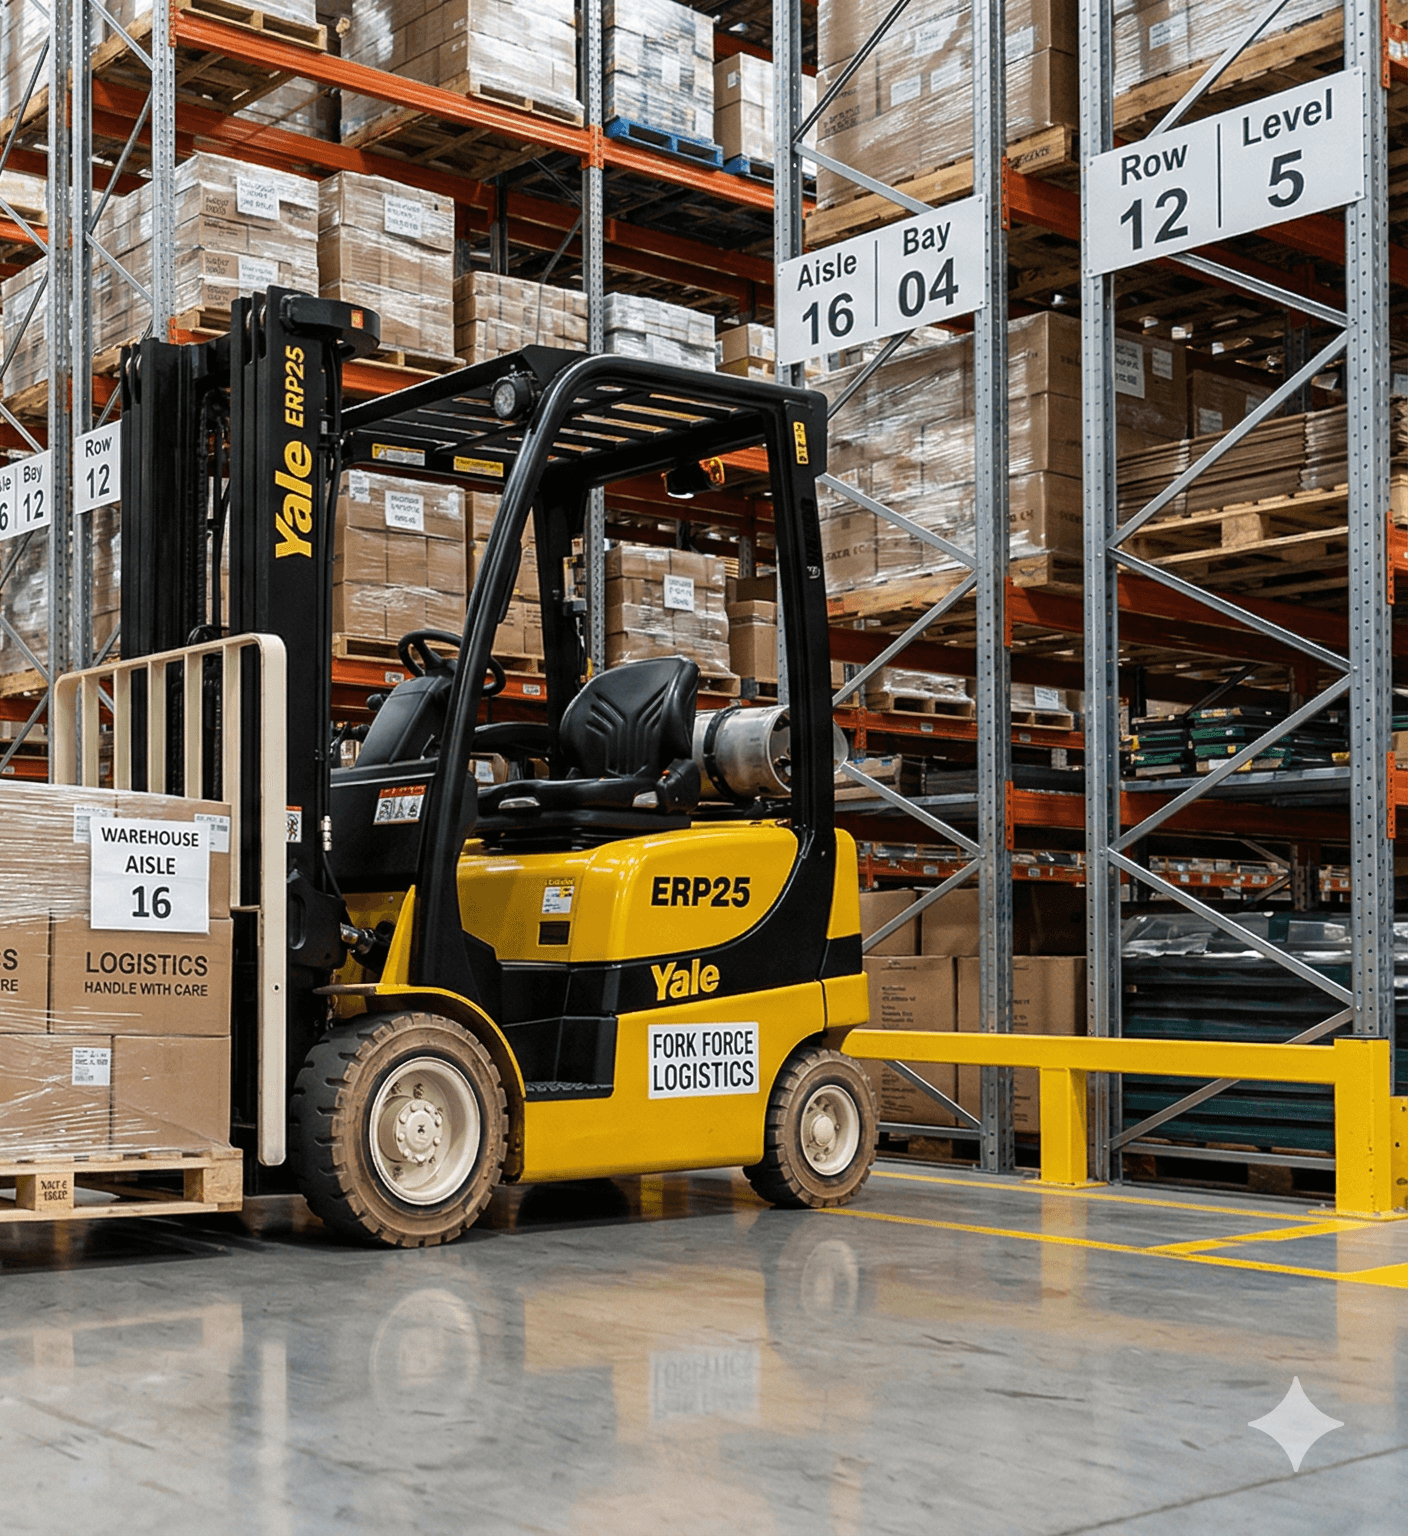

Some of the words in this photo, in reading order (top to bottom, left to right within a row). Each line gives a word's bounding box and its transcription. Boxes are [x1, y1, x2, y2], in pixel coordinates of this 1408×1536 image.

[1121, 144, 1188, 186] Row
[1243, 88, 1333, 147] Level
[1120, 187, 1189, 250] 12
[1268, 149, 1305, 208] 5
[797, 252, 857, 292] Aisle
[903, 221, 951, 257] Bay
[802, 292, 854, 345] 16
[898, 257, 959, 318] 04
[285, 345, 305, 428] ERP25
[85, 436, 112, 458] Row
[86, 463, 110, 499] 12
[23, 489, 44, 522] 12
[274, 440, 313, 558] Yale
[101, 827, 199, 848] WAREHOUSE
[125, 855, 176, 875] AISLE
[132, 885, 172, 919] 16
[650, 876, 751, 908] ERP25
[86, 951, 208, 977] LOGISTICS
[650, 958, 720, 1001] Yale
[84, 981, 137, 995] HANDLE
[140, 982, 171, 996] WITH
[174, 983, 208, 997] CARE
[653, 1032, 697, 1059] FORK
[702, 1030, 754, 1057] FORCE
[653, 1060, 755, 1091] LOGISTICS
